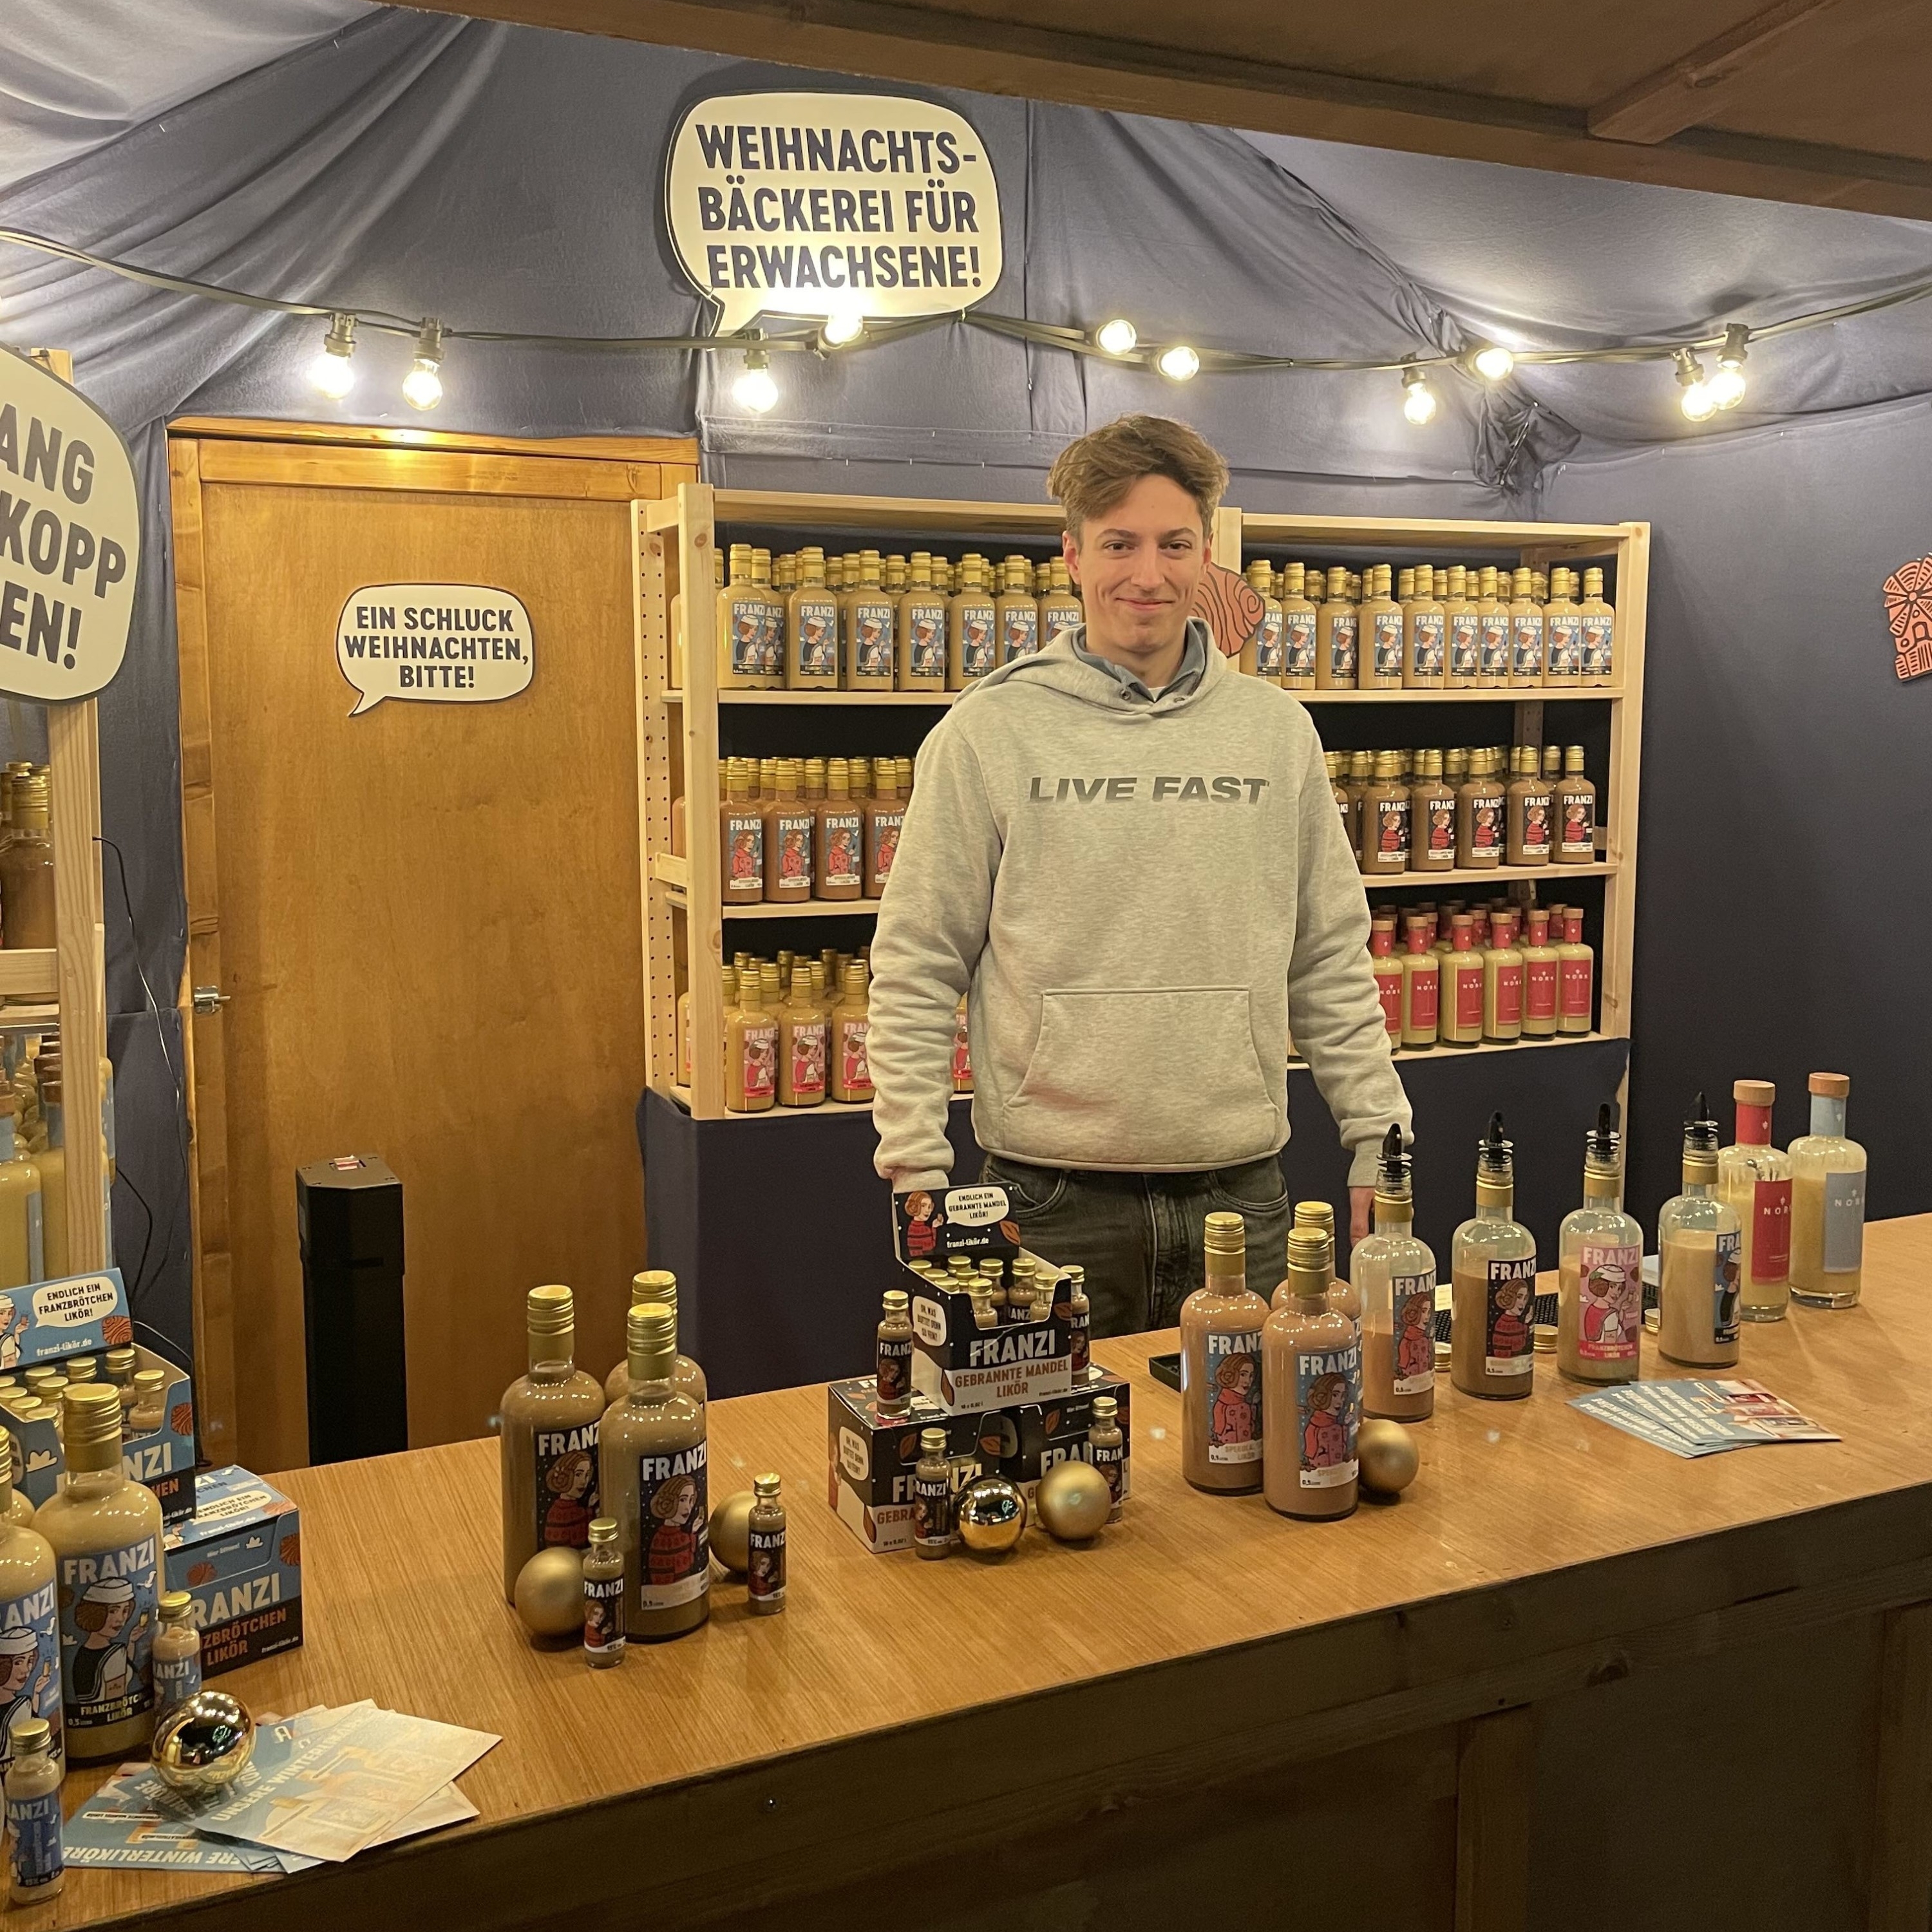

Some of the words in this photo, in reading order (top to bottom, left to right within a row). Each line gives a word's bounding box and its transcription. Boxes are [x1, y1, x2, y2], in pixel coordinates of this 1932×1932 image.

[696, 124, 977, 175] WEIHNACHTS-
[697, 175, 895, 232] BÄCKEREI
[906, 178, 980, 233] FÜR
[706, 245, 982, 289] ERWACHSENE!
[357, 606, 395, 630] EIN
[404, 607, 514, 632] SCHLUCK
[800, 605, 835, 618] FRANZI
[858, 607, 891, 619] FRANZI
[345, 635, 529, 665] WEIHNACHTEN,
[399, 665, 475, 688] BITTE!
[1030, 777, 1137, 803] LIVE
[1152, 776, 1270, 805] FAST
[1564, 795, 1593, 805] FRANZI
[826, 817, 858, 829] FRANZI
[39, 1292, 113, 1315] FRANZBRÖTCHEN
[47, 1286, 84, 1301] ENDLICH
[86, 1283, 101, 1294] EIN
[64, 1309, 93, 1321] LIKÖR!
[37, 1338, 92, 1356] franzi-likör.de
[970, 1329, 1055, 1367] FRANZI
[955, 1367, 1022, 1388] GEBRANNTE
[1026, 1359, 1068, 1378] MANDEL
[996, 1380, 1028, 1398] LIKÖR
[64, 1539, 155, 1585] FRANZI
[584, 1578, 623, 1599] FRANZI
[207, 1640, 248, 1666] LIKÖR
[211, 1784, 276, 1822] UNSERE
